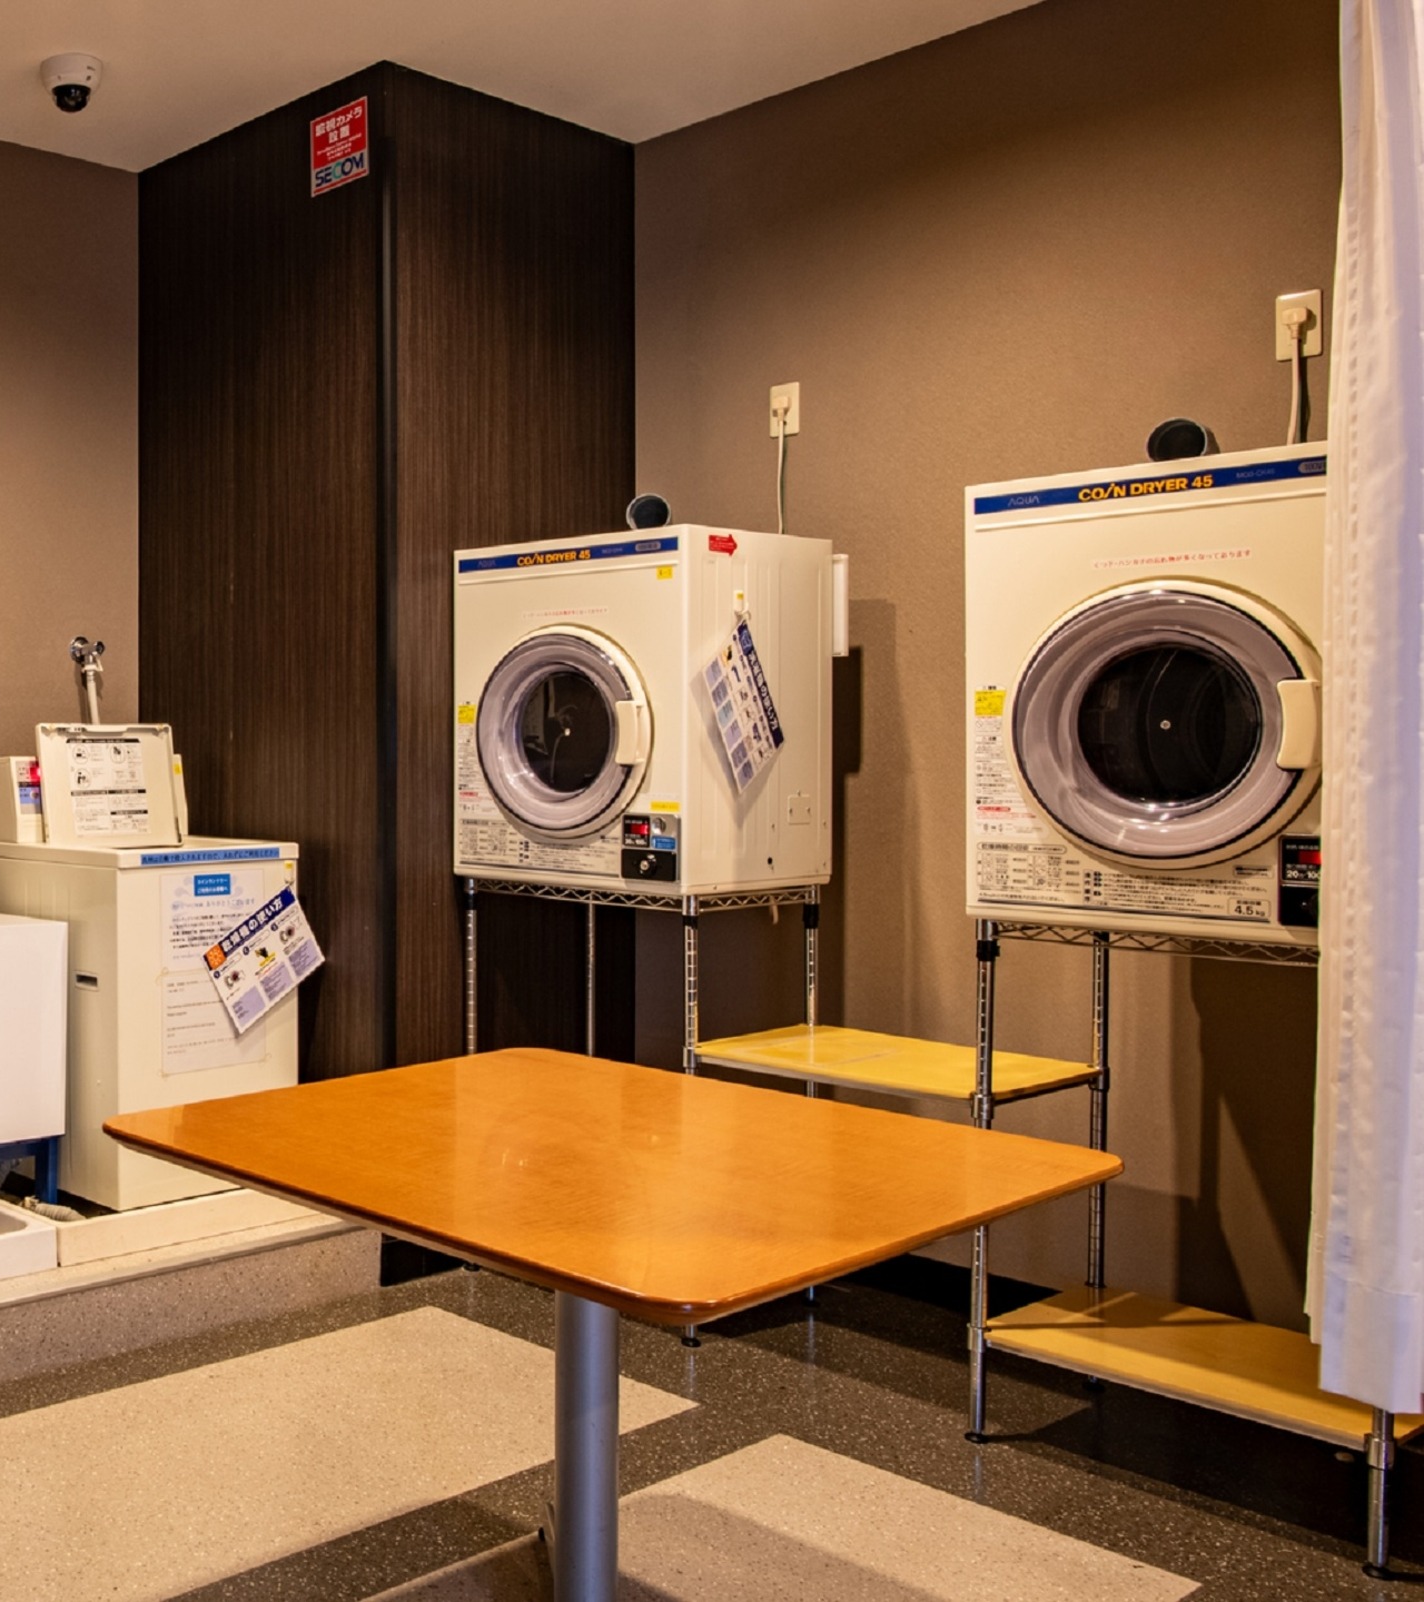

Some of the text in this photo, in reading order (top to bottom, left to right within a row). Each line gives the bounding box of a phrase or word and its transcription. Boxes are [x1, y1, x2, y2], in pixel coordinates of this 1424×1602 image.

[315, 152, 364, 187] SECOM
[1129, 478, 1187, 497] DRYER
[1191, 475, 1214, 489] 45
[1007, 495, 1040, 507] AQUA
[545, 551, 577, 564] DRYER
[578, 549, 591, 561] 45
[1234, 905, 1254, 916] 4.5
